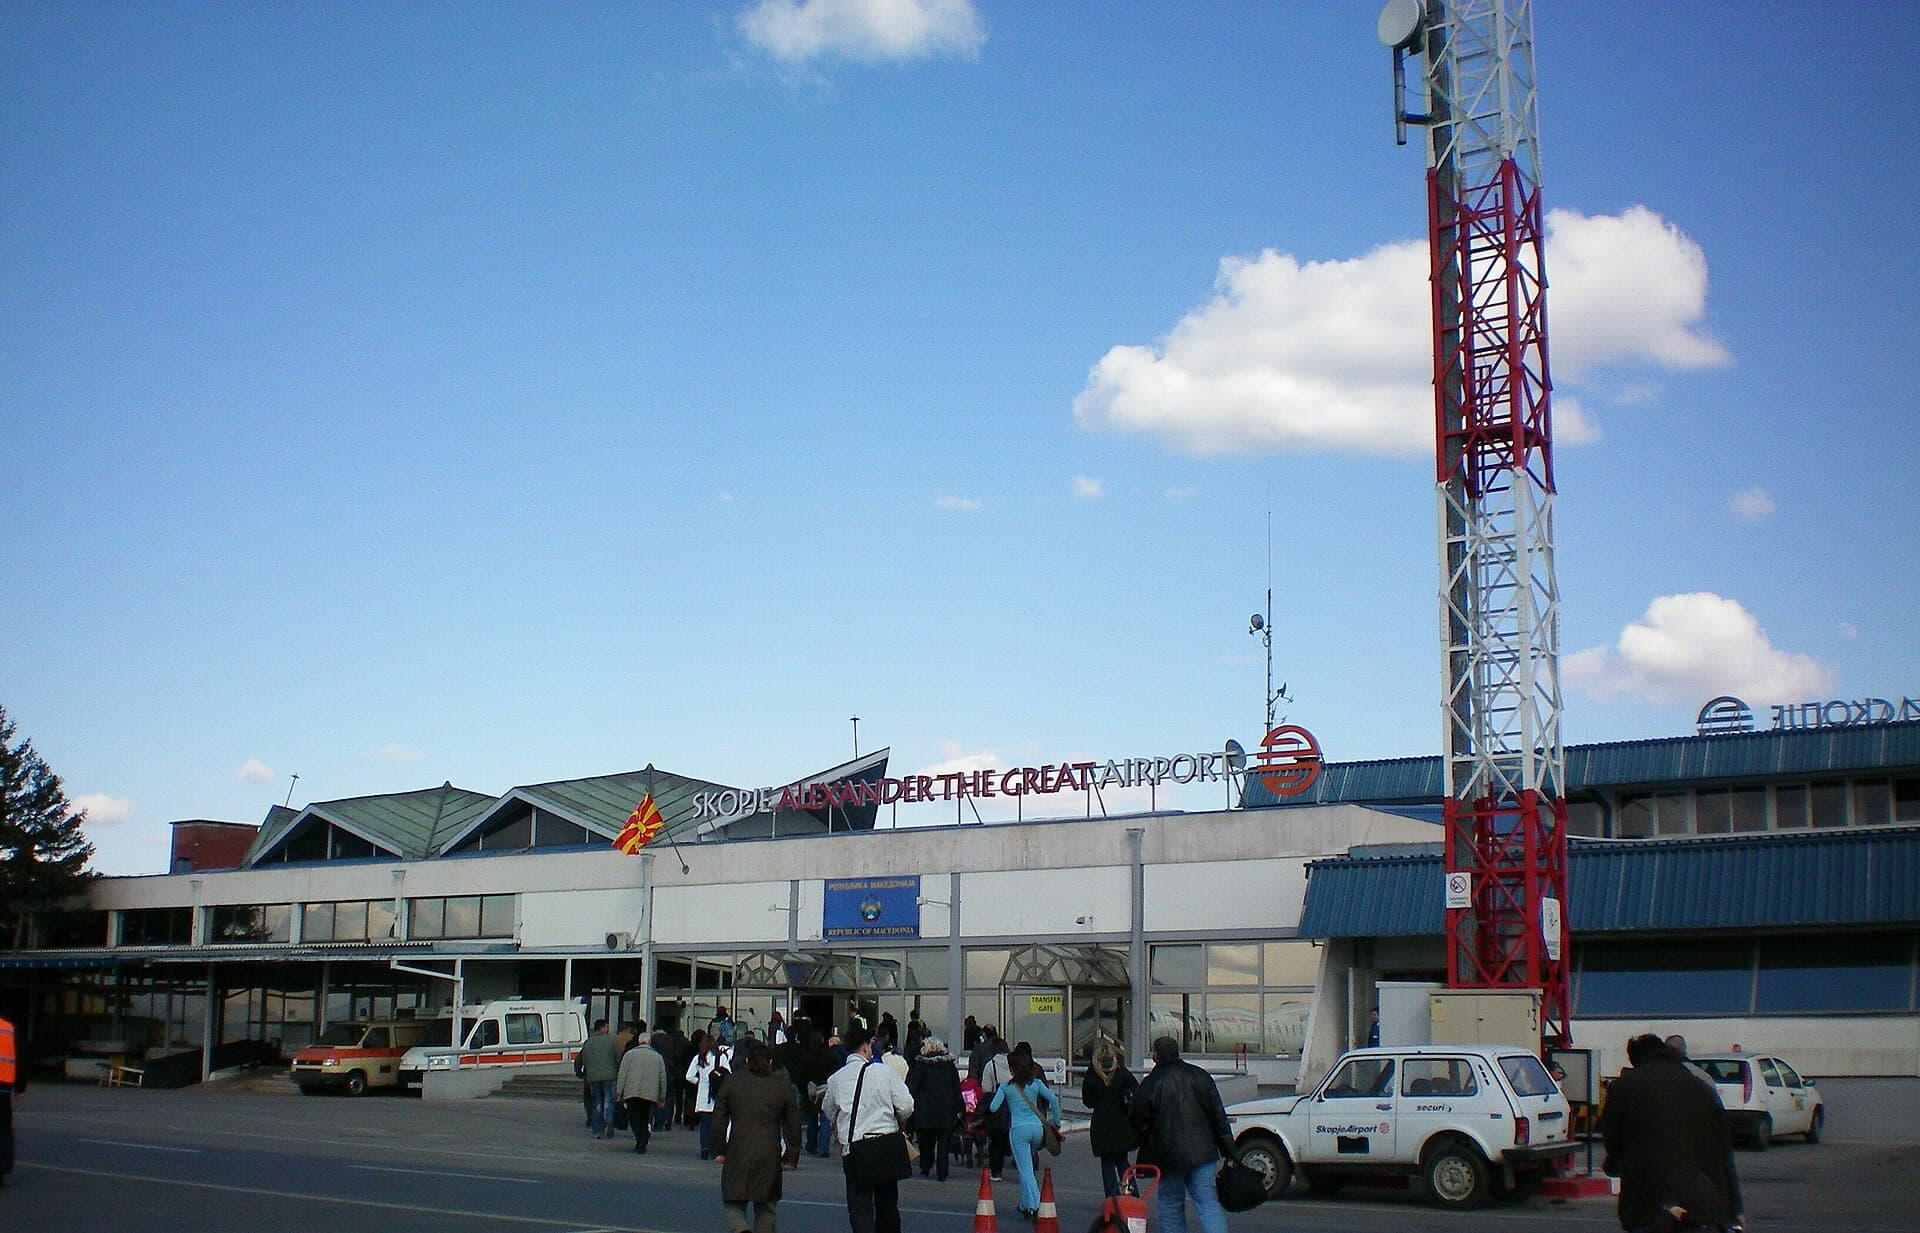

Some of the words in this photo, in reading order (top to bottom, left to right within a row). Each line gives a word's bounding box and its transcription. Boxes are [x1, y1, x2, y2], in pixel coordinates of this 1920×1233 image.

[692, 786, 774, 819] SKOPJE
[774, 774, 936, 813] ALEXANDER
[936, 768, 996, 801] THE
[1000, 761, 1096, 797] GREAT
[1100, 750, 1241, 790] AIRPORT
[828, 928, 861, 936] REPUBLIC
[862, 927, 872, 935] OF
[873, 926, 914, 935] MACEDONIA
